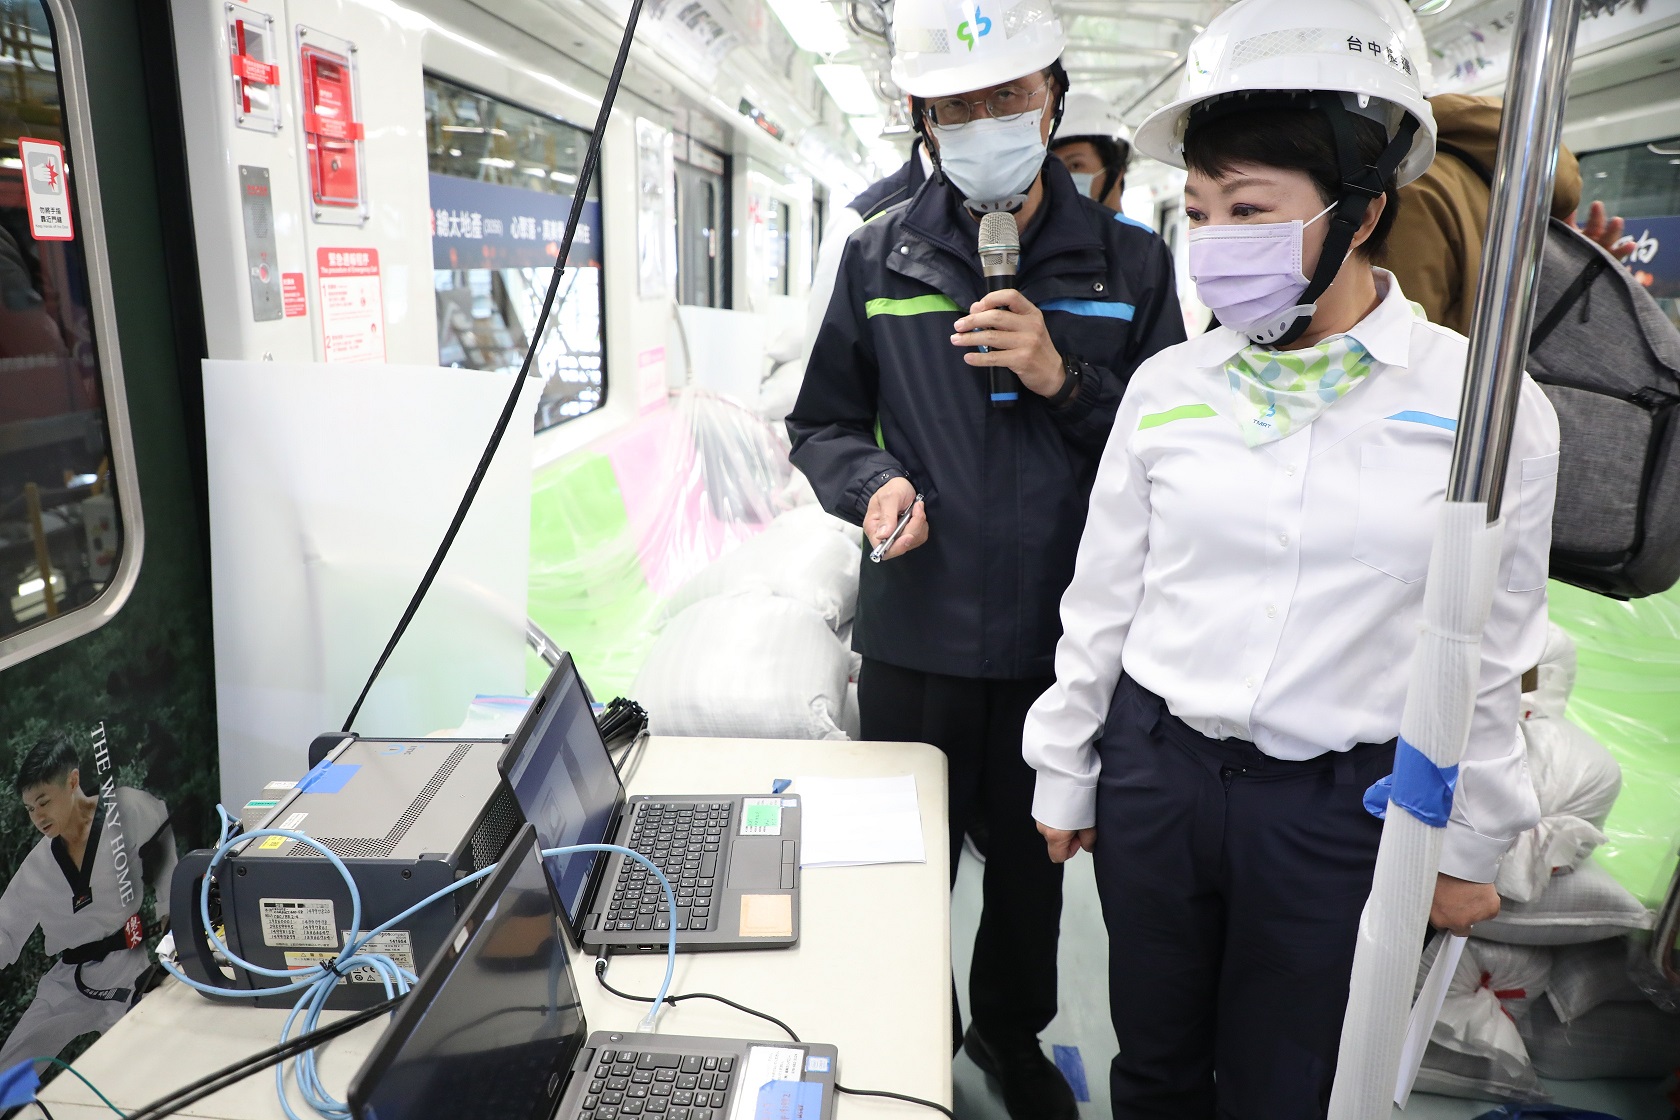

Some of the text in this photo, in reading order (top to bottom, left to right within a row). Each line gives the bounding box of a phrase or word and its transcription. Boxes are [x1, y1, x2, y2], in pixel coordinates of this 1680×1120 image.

[90, 721, 135, 908] THE WAY HOME
